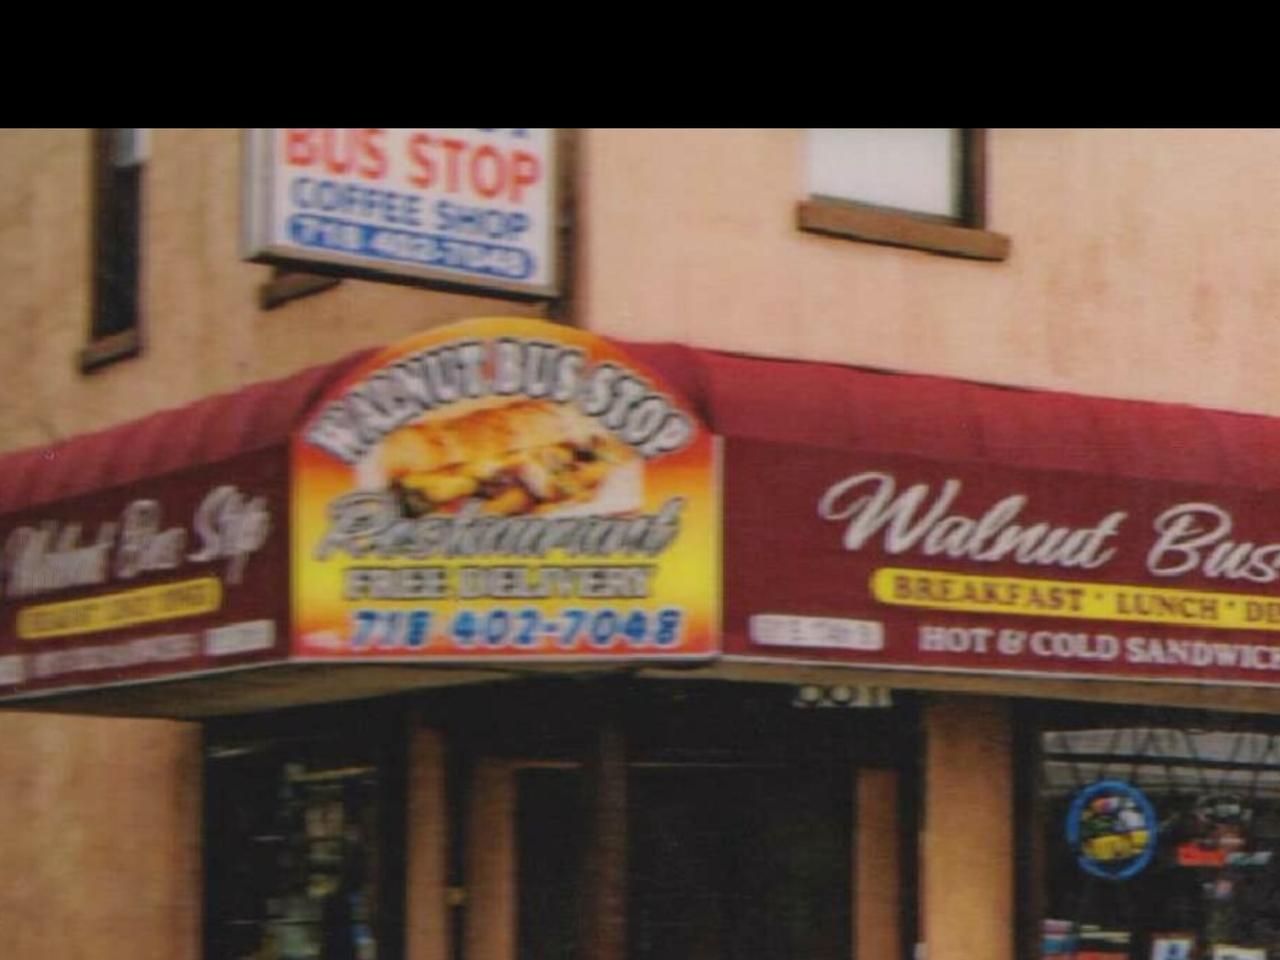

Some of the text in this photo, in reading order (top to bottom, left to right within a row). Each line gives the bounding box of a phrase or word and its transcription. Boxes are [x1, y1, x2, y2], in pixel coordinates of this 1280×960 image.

[285, 127, 540, 204] BUS STOP
[290, 176, 531, 239] COFFEE SHOP
[307, 337, 694, 465] WALNUT BUS STOP
[819, 470, 1126, 570] Walnut
[344, 565, 658, 600] FREE DELIVERY
[892, 574, 1084, 611] BREAKFAST
[1115, 591, 1221, 621] LUNCH
[353, 608, 684, 648] 718 402-7048
[919, 624, 994, 653] HOT
[997, 628, 1026, 655] &
[1029, 630, 1120, 659] COLD
